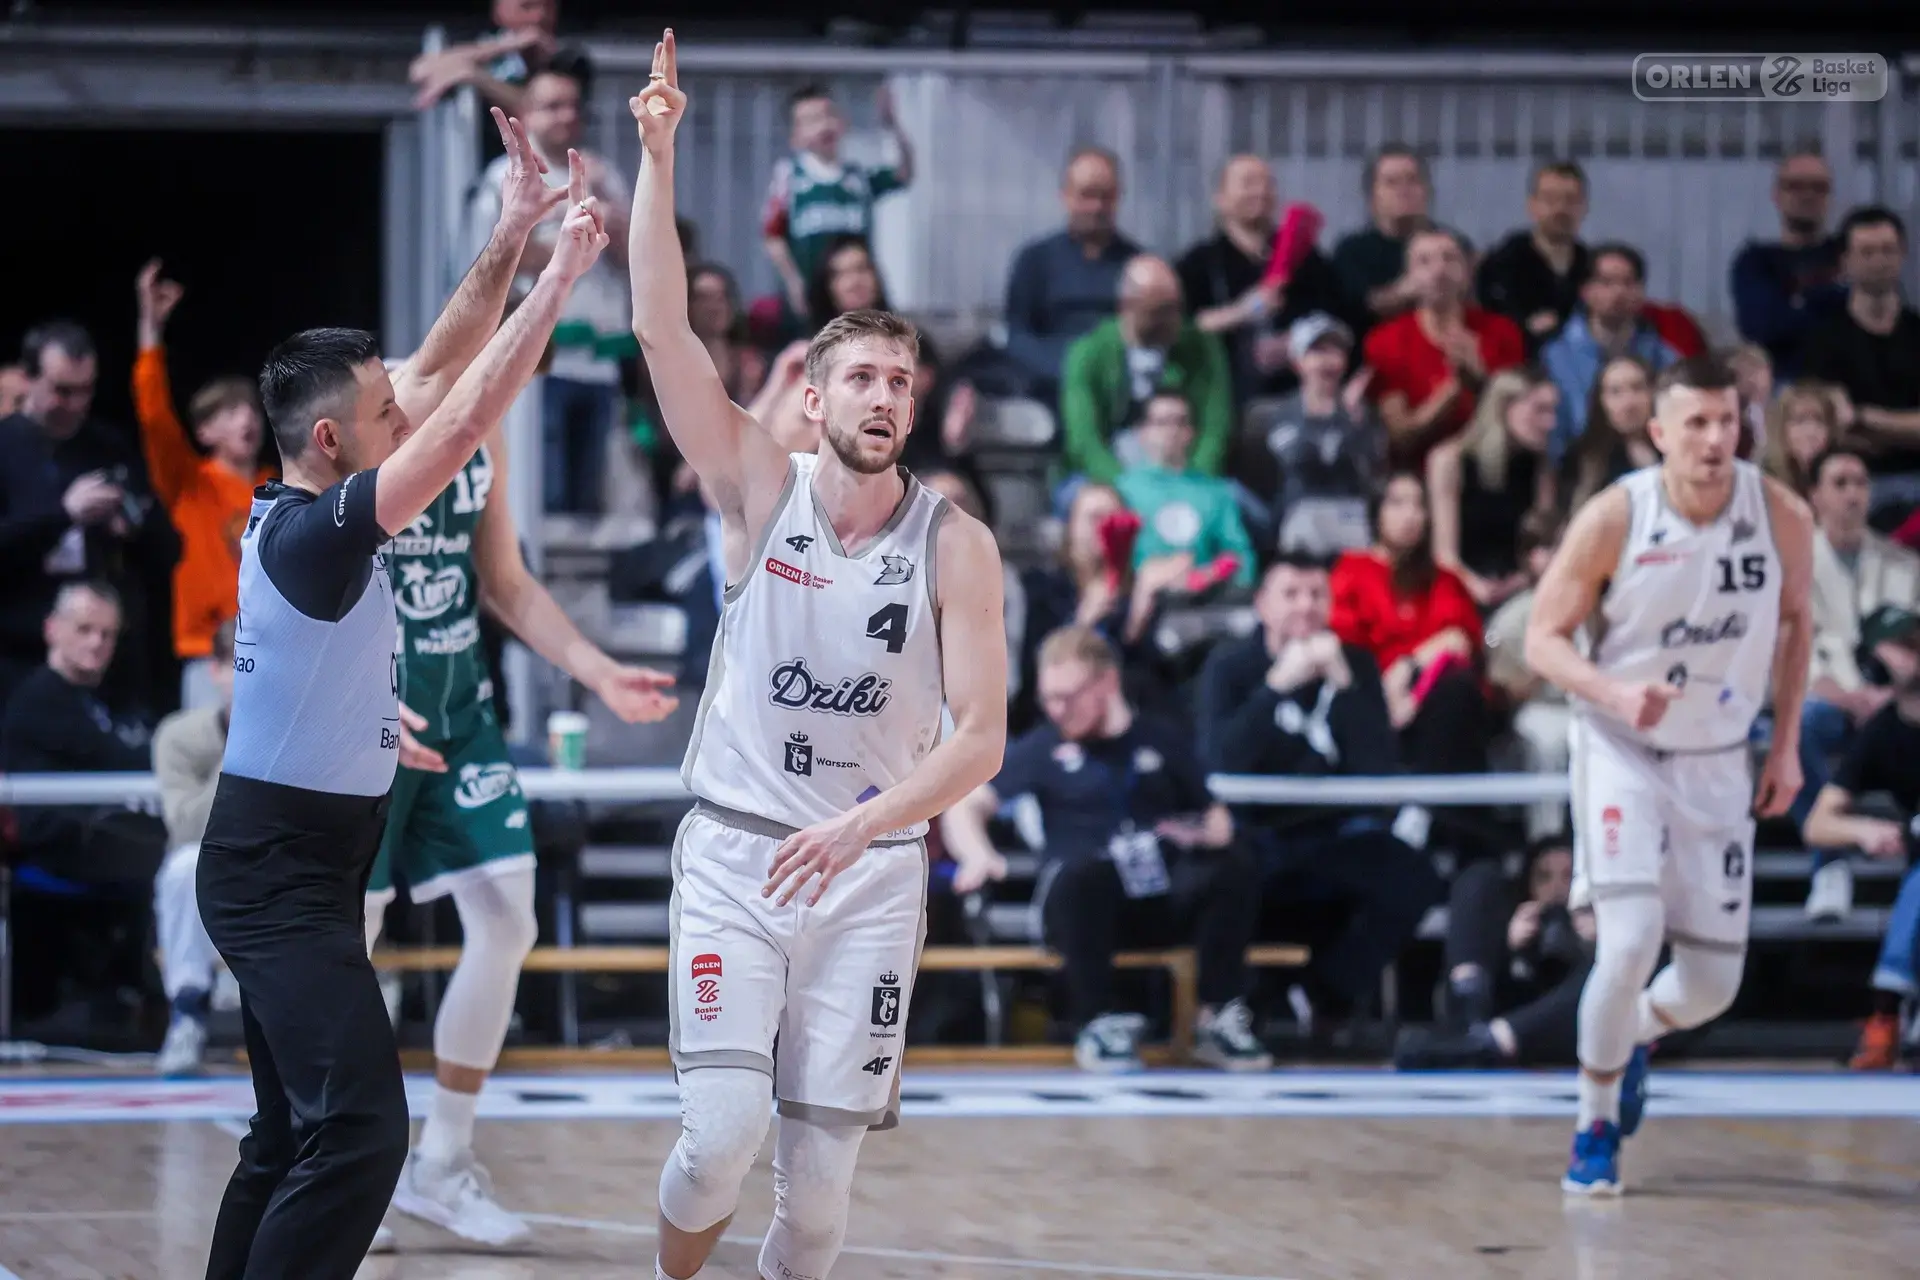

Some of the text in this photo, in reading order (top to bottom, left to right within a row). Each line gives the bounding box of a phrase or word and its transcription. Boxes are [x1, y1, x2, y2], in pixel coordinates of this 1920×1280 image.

[768, 561, 800, 581] ORLEN
[1717, 554, 1766, 593] 15
[812, 581, 825, 589] Liga
[813, 575, 834, 585] Basket
[866, 602, 909, 654] 4
[771, 660, 889, 715] Dziki
[380, 727, 400, 750] Ban
[693, 961, 720, 970] ORLEN
[694, 1006, 722, 1014] Basket
[700, 1013, 718, 1022] Liga
